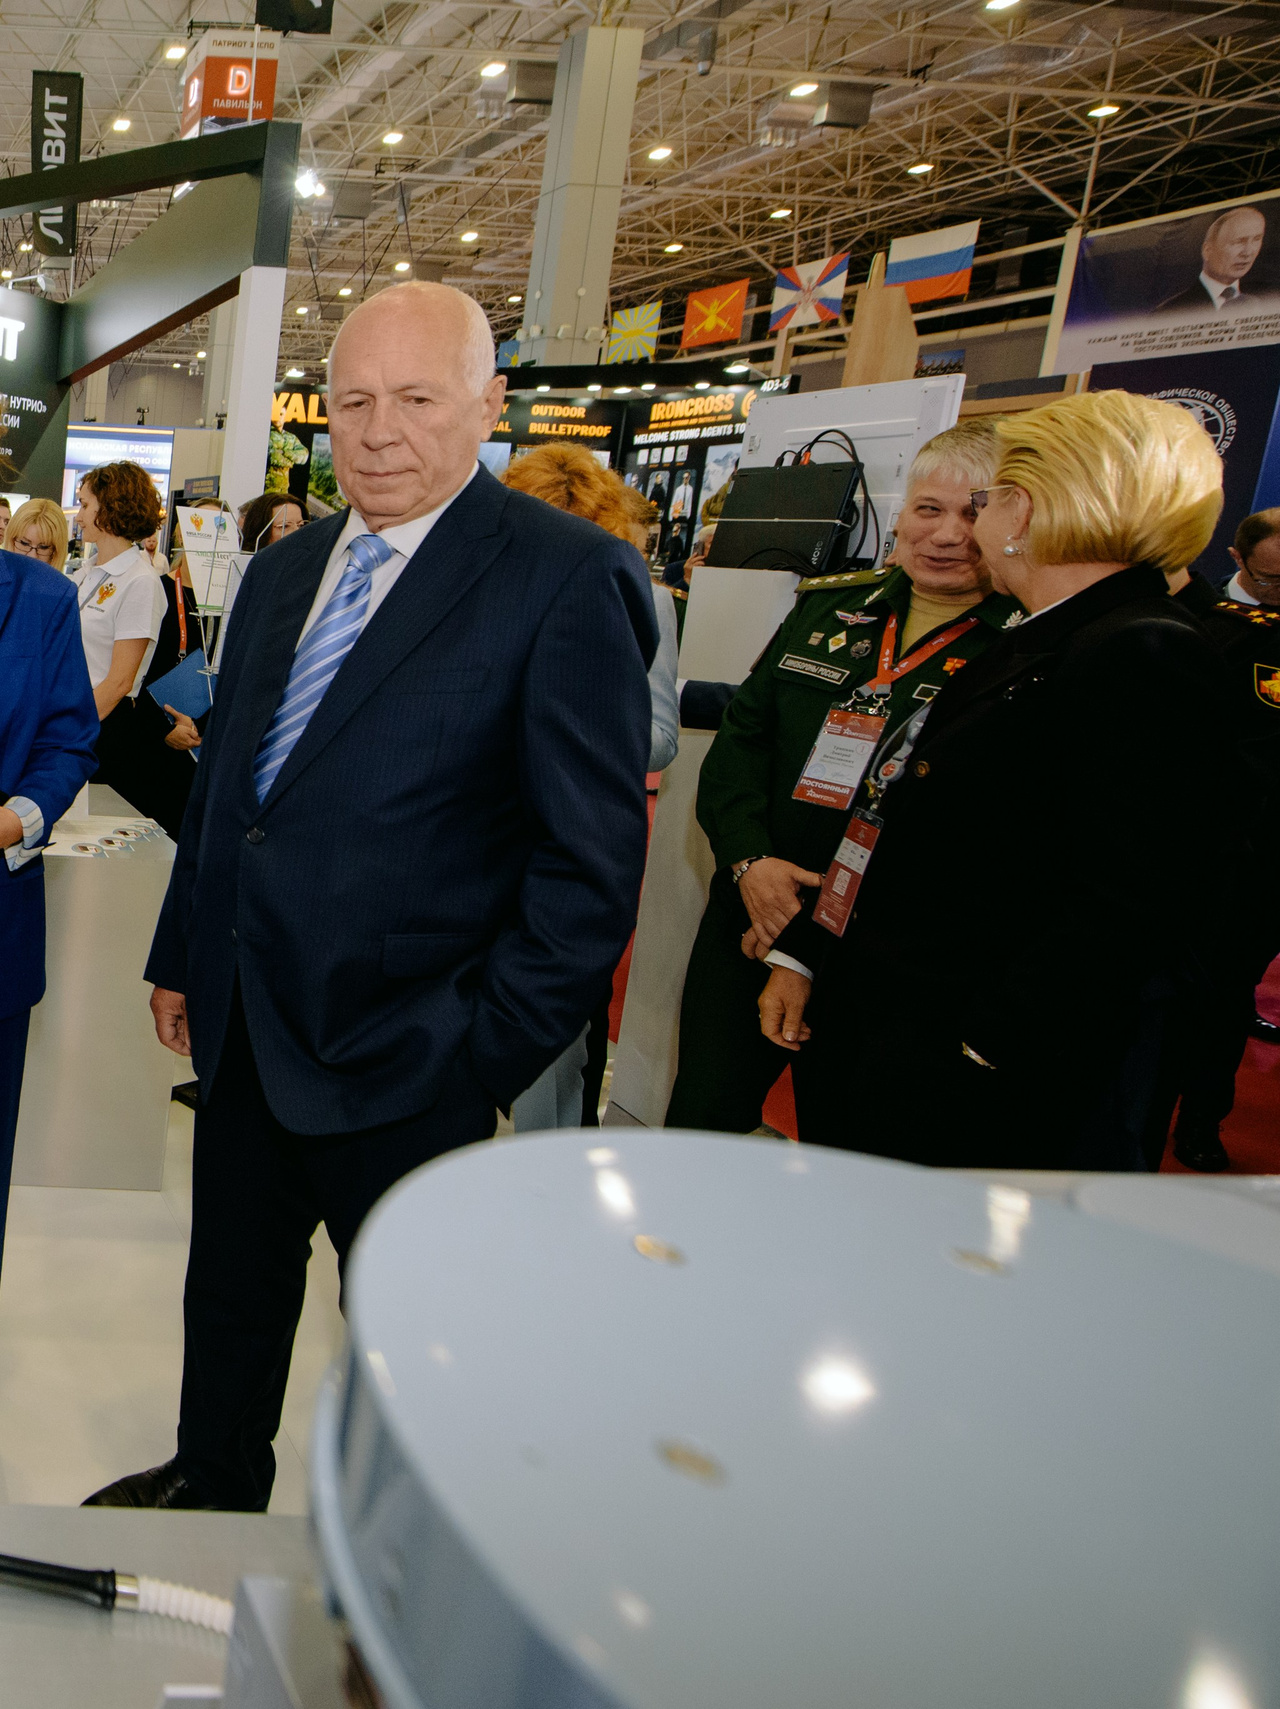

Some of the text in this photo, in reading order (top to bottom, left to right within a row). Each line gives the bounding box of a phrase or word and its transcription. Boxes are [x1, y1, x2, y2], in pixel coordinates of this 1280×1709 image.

[212, 39, 247, 49] ПАТРИОТ
[228, 65, 252, 95] D
[38, 87, 68, 245] ЛВИТ
[760, 377, 790, 393] 4D3-6
[10, 393, 47, 414] НУТРИО»
[531, 404, 587, 419] OUTDOOR
[649, 392, 736, 422] IRONCROSS
[528, 422, 612, 438] BULLETPROOF
[633, 430, 669, 446] WELCOME
[670, 427, 700, 442] STRONG
[700, 424, 733, 438] AGENTS
[1215, 397, 1238, 457] ОБЩЕСТВО
[800, 778, 850, 795] ПОСТОЯННЫЙ
